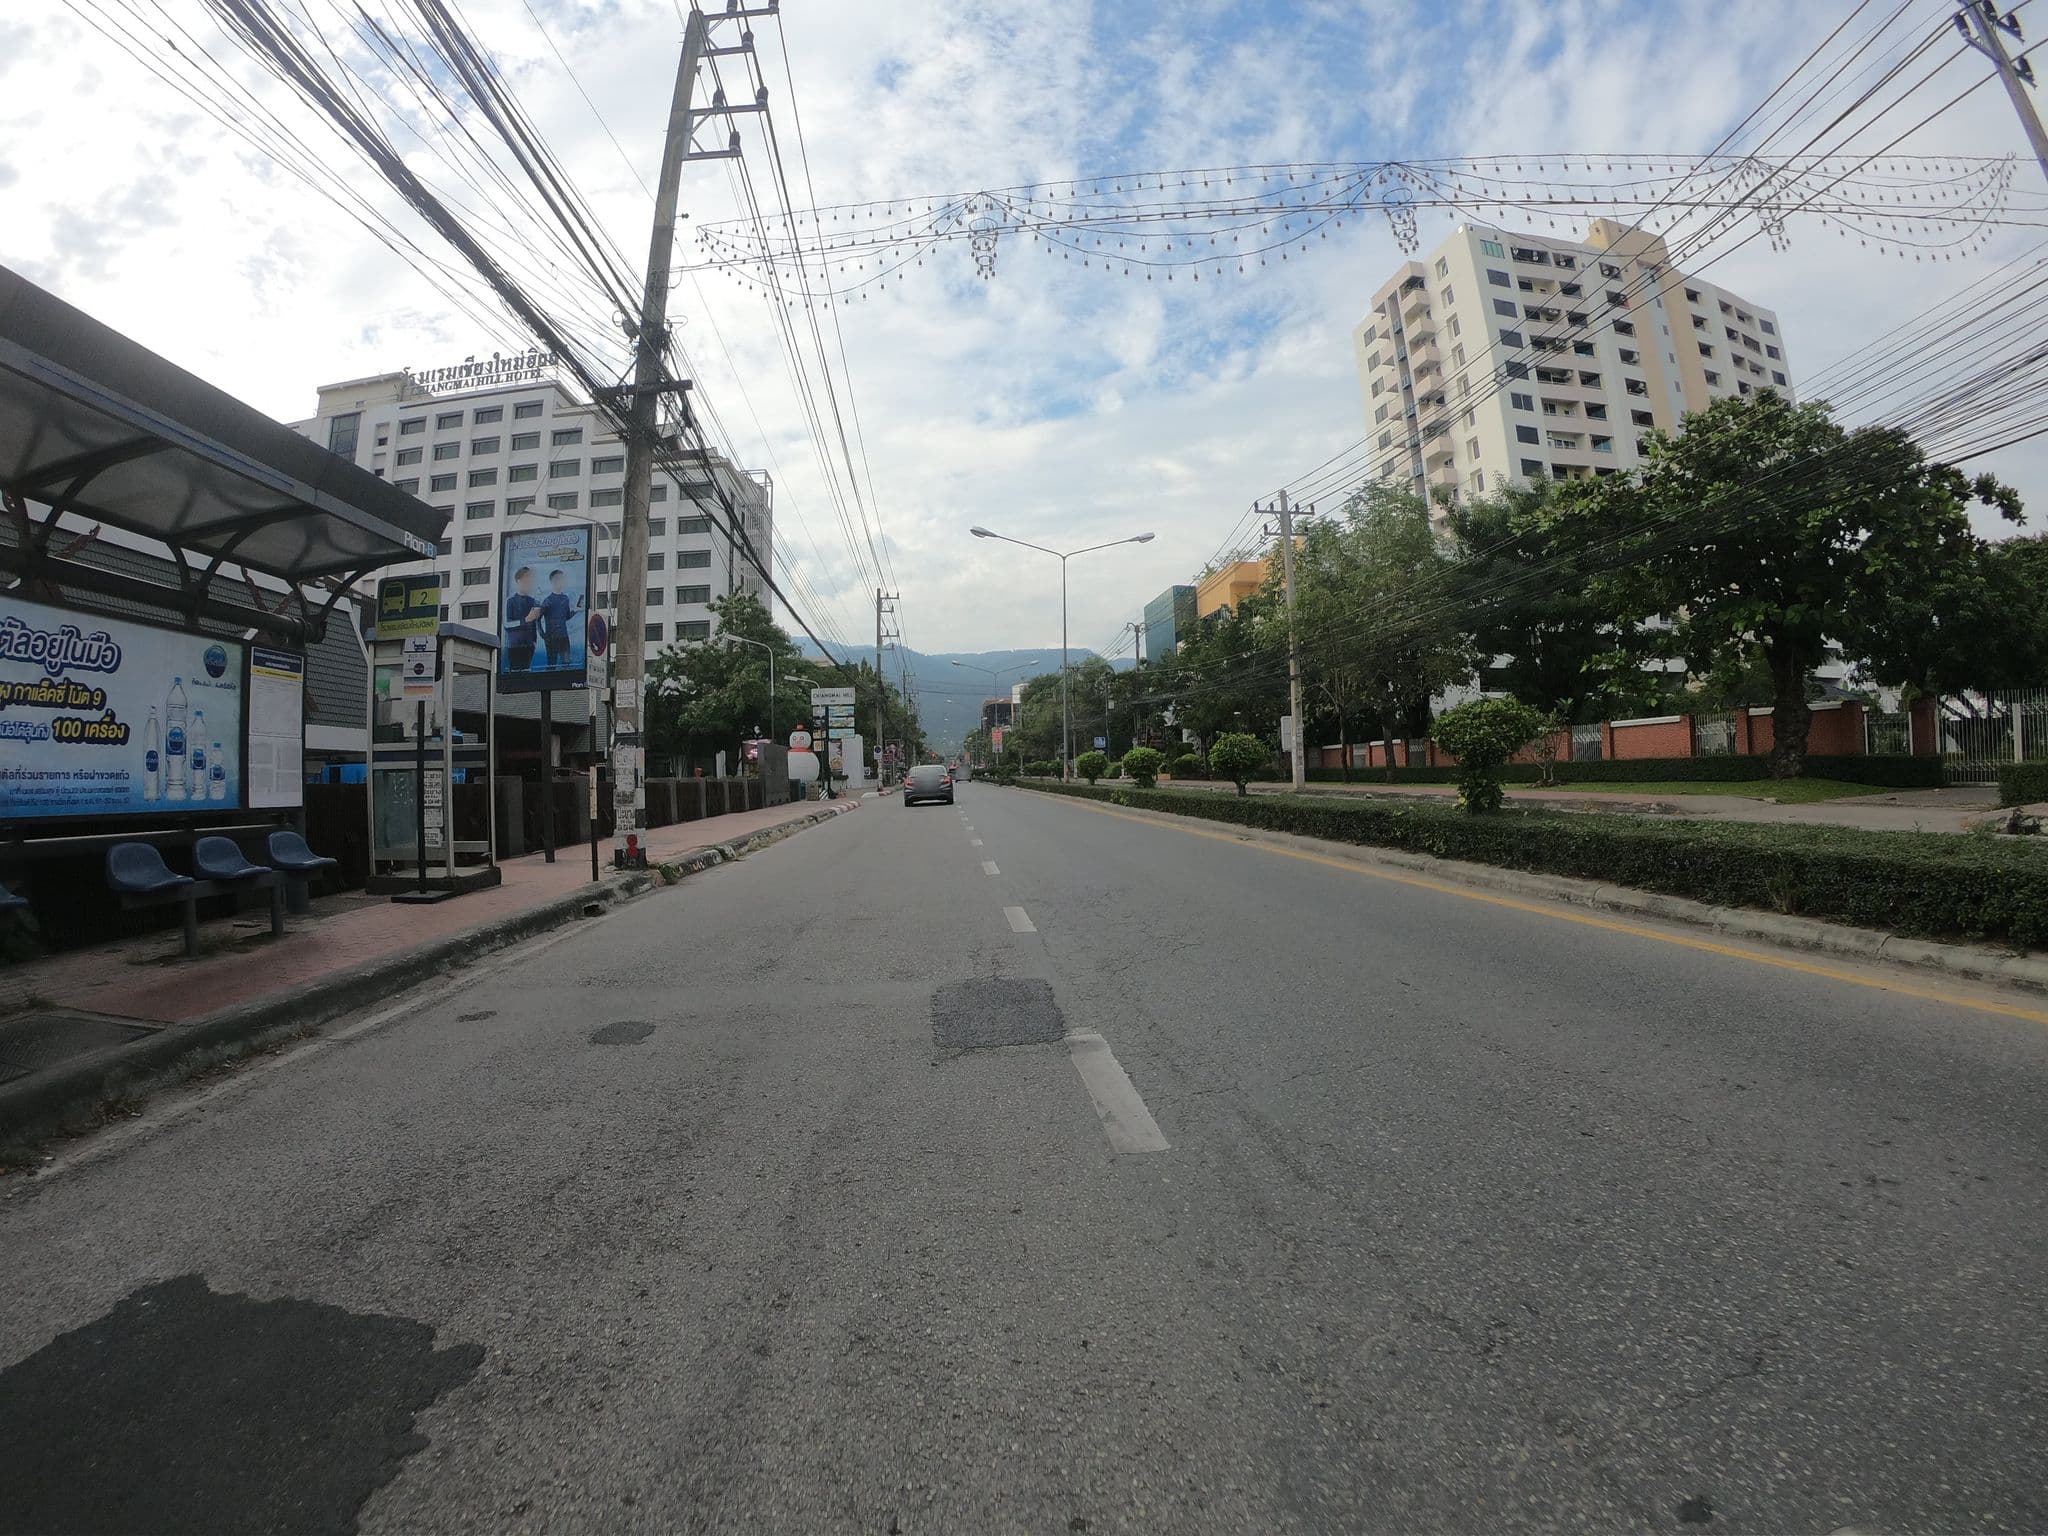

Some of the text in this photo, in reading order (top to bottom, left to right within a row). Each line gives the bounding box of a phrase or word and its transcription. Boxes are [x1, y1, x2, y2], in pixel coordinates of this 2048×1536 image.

[477, 374, 503, 387] HILL
[505, 368, 544, 383] HOTEL
[420, 592, 428, 605] 2
[93, 690, 102, 705] 9
[53, 721, 81, 738] 100
[84, 709, 125, 738] เครื่อง
